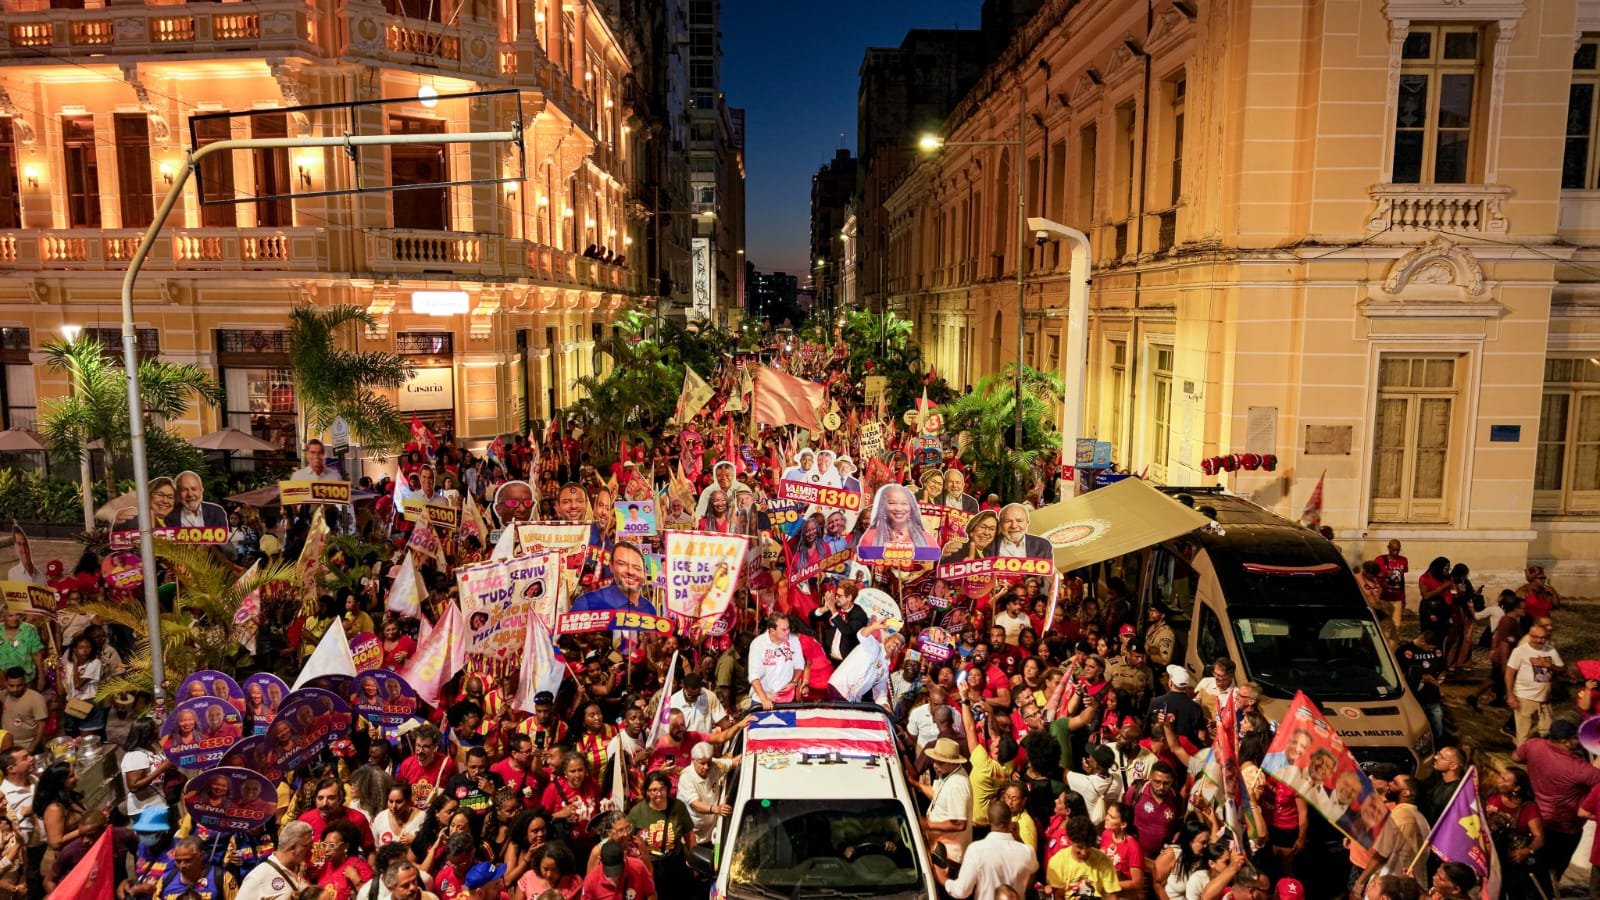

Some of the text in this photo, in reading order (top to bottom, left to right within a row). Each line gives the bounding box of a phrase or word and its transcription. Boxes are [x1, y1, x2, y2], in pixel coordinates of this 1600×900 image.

[407, 383, 443, 393] Casaria
[312, 485, 348, 499] 13100
[785, 483, 859, 509] VALMIR 1310
[427, 507, 454, 522] 3100
[624, 523, 650, 531] 4005
[177, 528, 226, 542] 4040
[884, 549, 914, 560] 6550
[698, 562, 710, 573] DE
[992, 558, 1051, 574] 4040
[675, 588, 688, 600] DA
[560, 621, 592, 633] REIS
[561, 611, 610, 623] LUCAS
[615, 612, 671, 633] 1330
[353, 645, 381, 665] 4040
[199, 736, 234, 750] 6550
[225, 808, 265, 820] 6550
